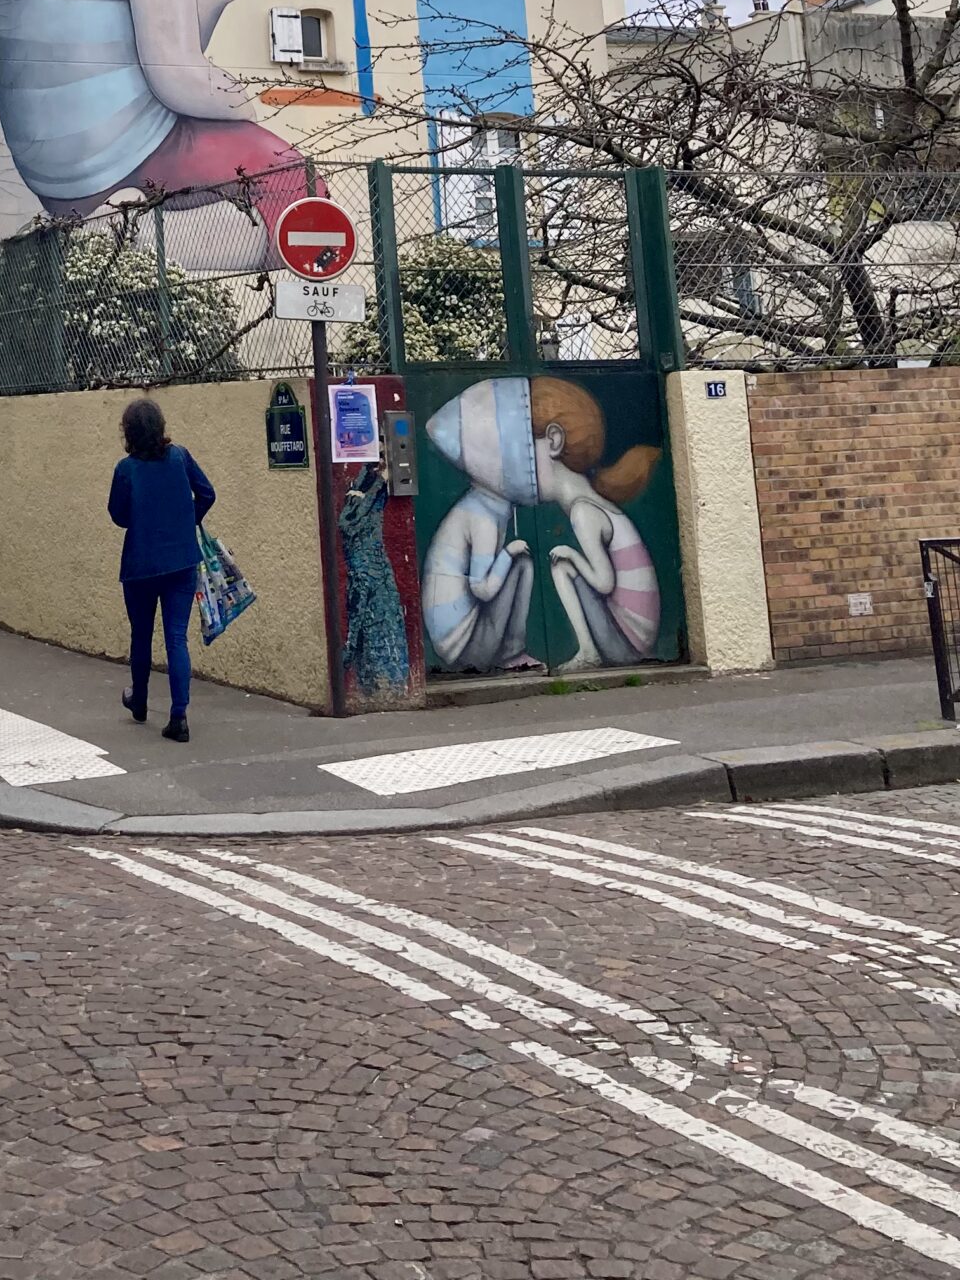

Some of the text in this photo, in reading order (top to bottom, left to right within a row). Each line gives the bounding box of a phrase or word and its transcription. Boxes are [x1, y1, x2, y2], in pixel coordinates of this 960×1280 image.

[303, 286, 339, 297] SAUF
[709, 383, 725, 396] 16
[280, 424, 291, 435] RUE
[270, 440, 304, 452] MOUFFETARD
